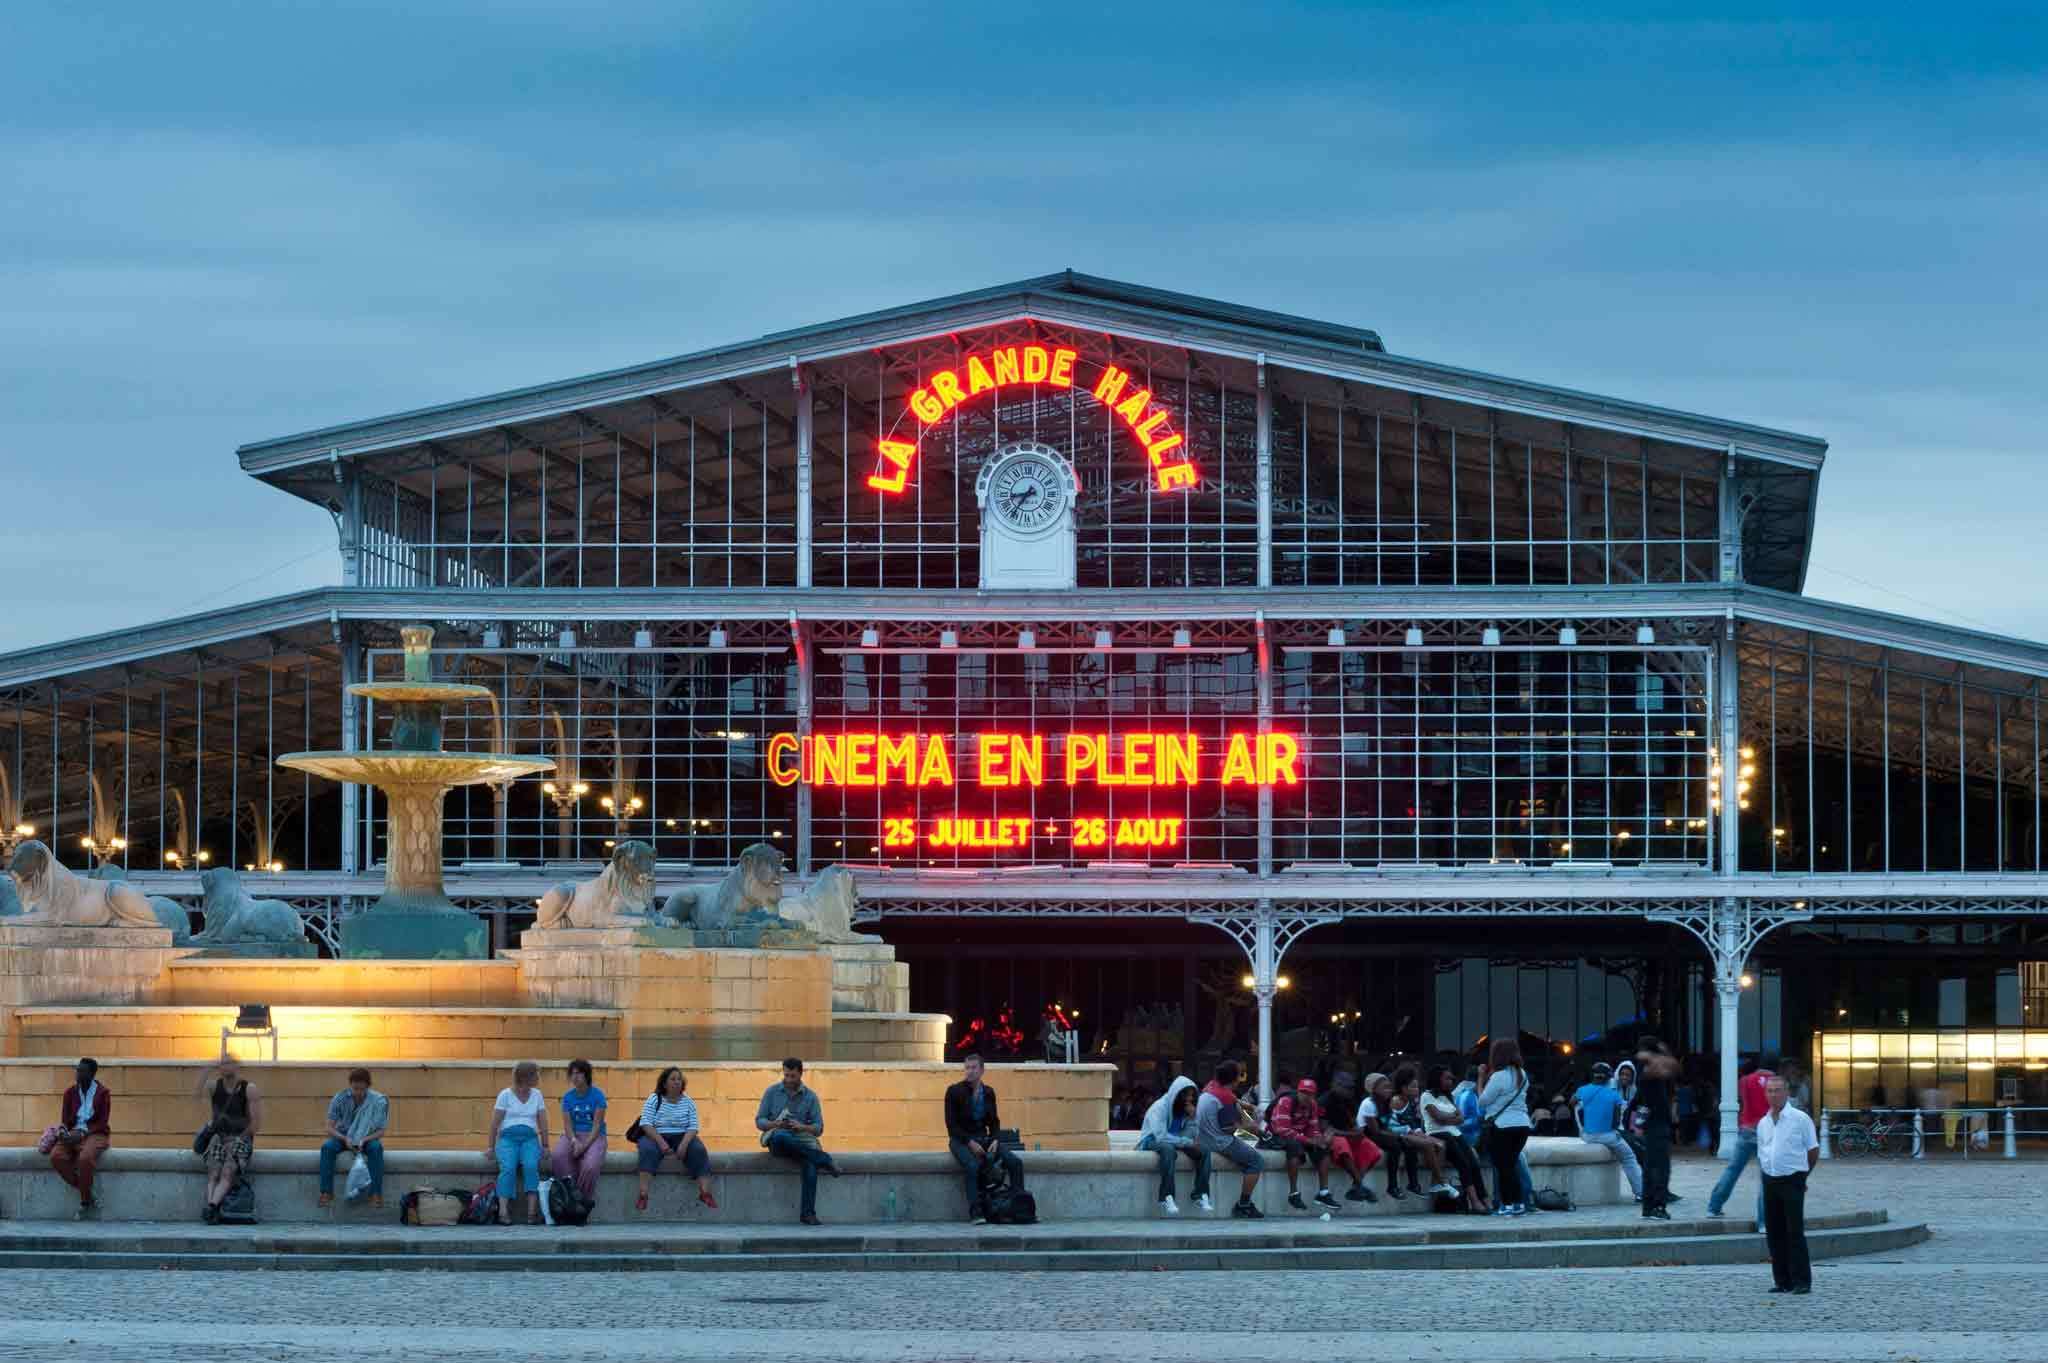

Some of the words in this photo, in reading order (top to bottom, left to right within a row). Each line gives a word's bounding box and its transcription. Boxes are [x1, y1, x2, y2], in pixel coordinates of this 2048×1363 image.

[868, 439, 917, 493] LA
[908, 346, 1077, 425] GRANDE
[1093, 365, 1197, 492] HALLE
[768, 732, 954, 787] CINEMA
[978, 732, 1043, 787] EN
[1066, 732, 1199, 786] PLEIN
[1221, 732, 1298, 786] AIR
[884, 817, 916, 846] 25
[928, 817, 1031, 846] JUILLET
[1073, 818, 1106, 846] 26
[1115, 818, 1183, 846] AOUT
